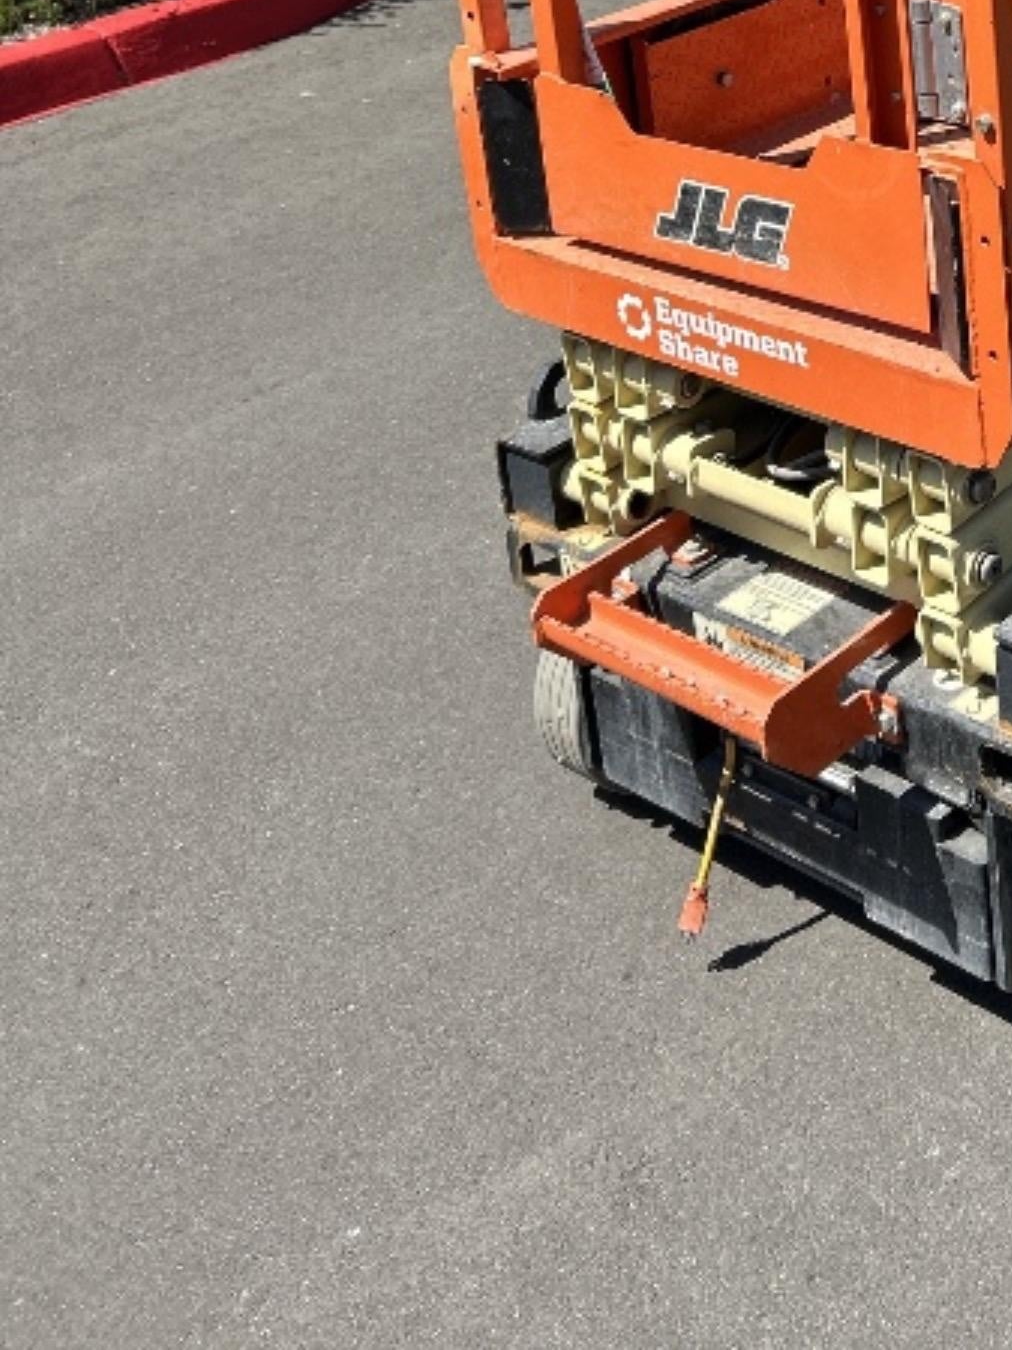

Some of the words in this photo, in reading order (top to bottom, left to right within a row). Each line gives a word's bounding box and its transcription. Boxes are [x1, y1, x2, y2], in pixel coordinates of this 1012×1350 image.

[654, 179, 795, 269] JLG
[653, 296, 809, 368] Equipment
[658, 326, 739, 377] Share
